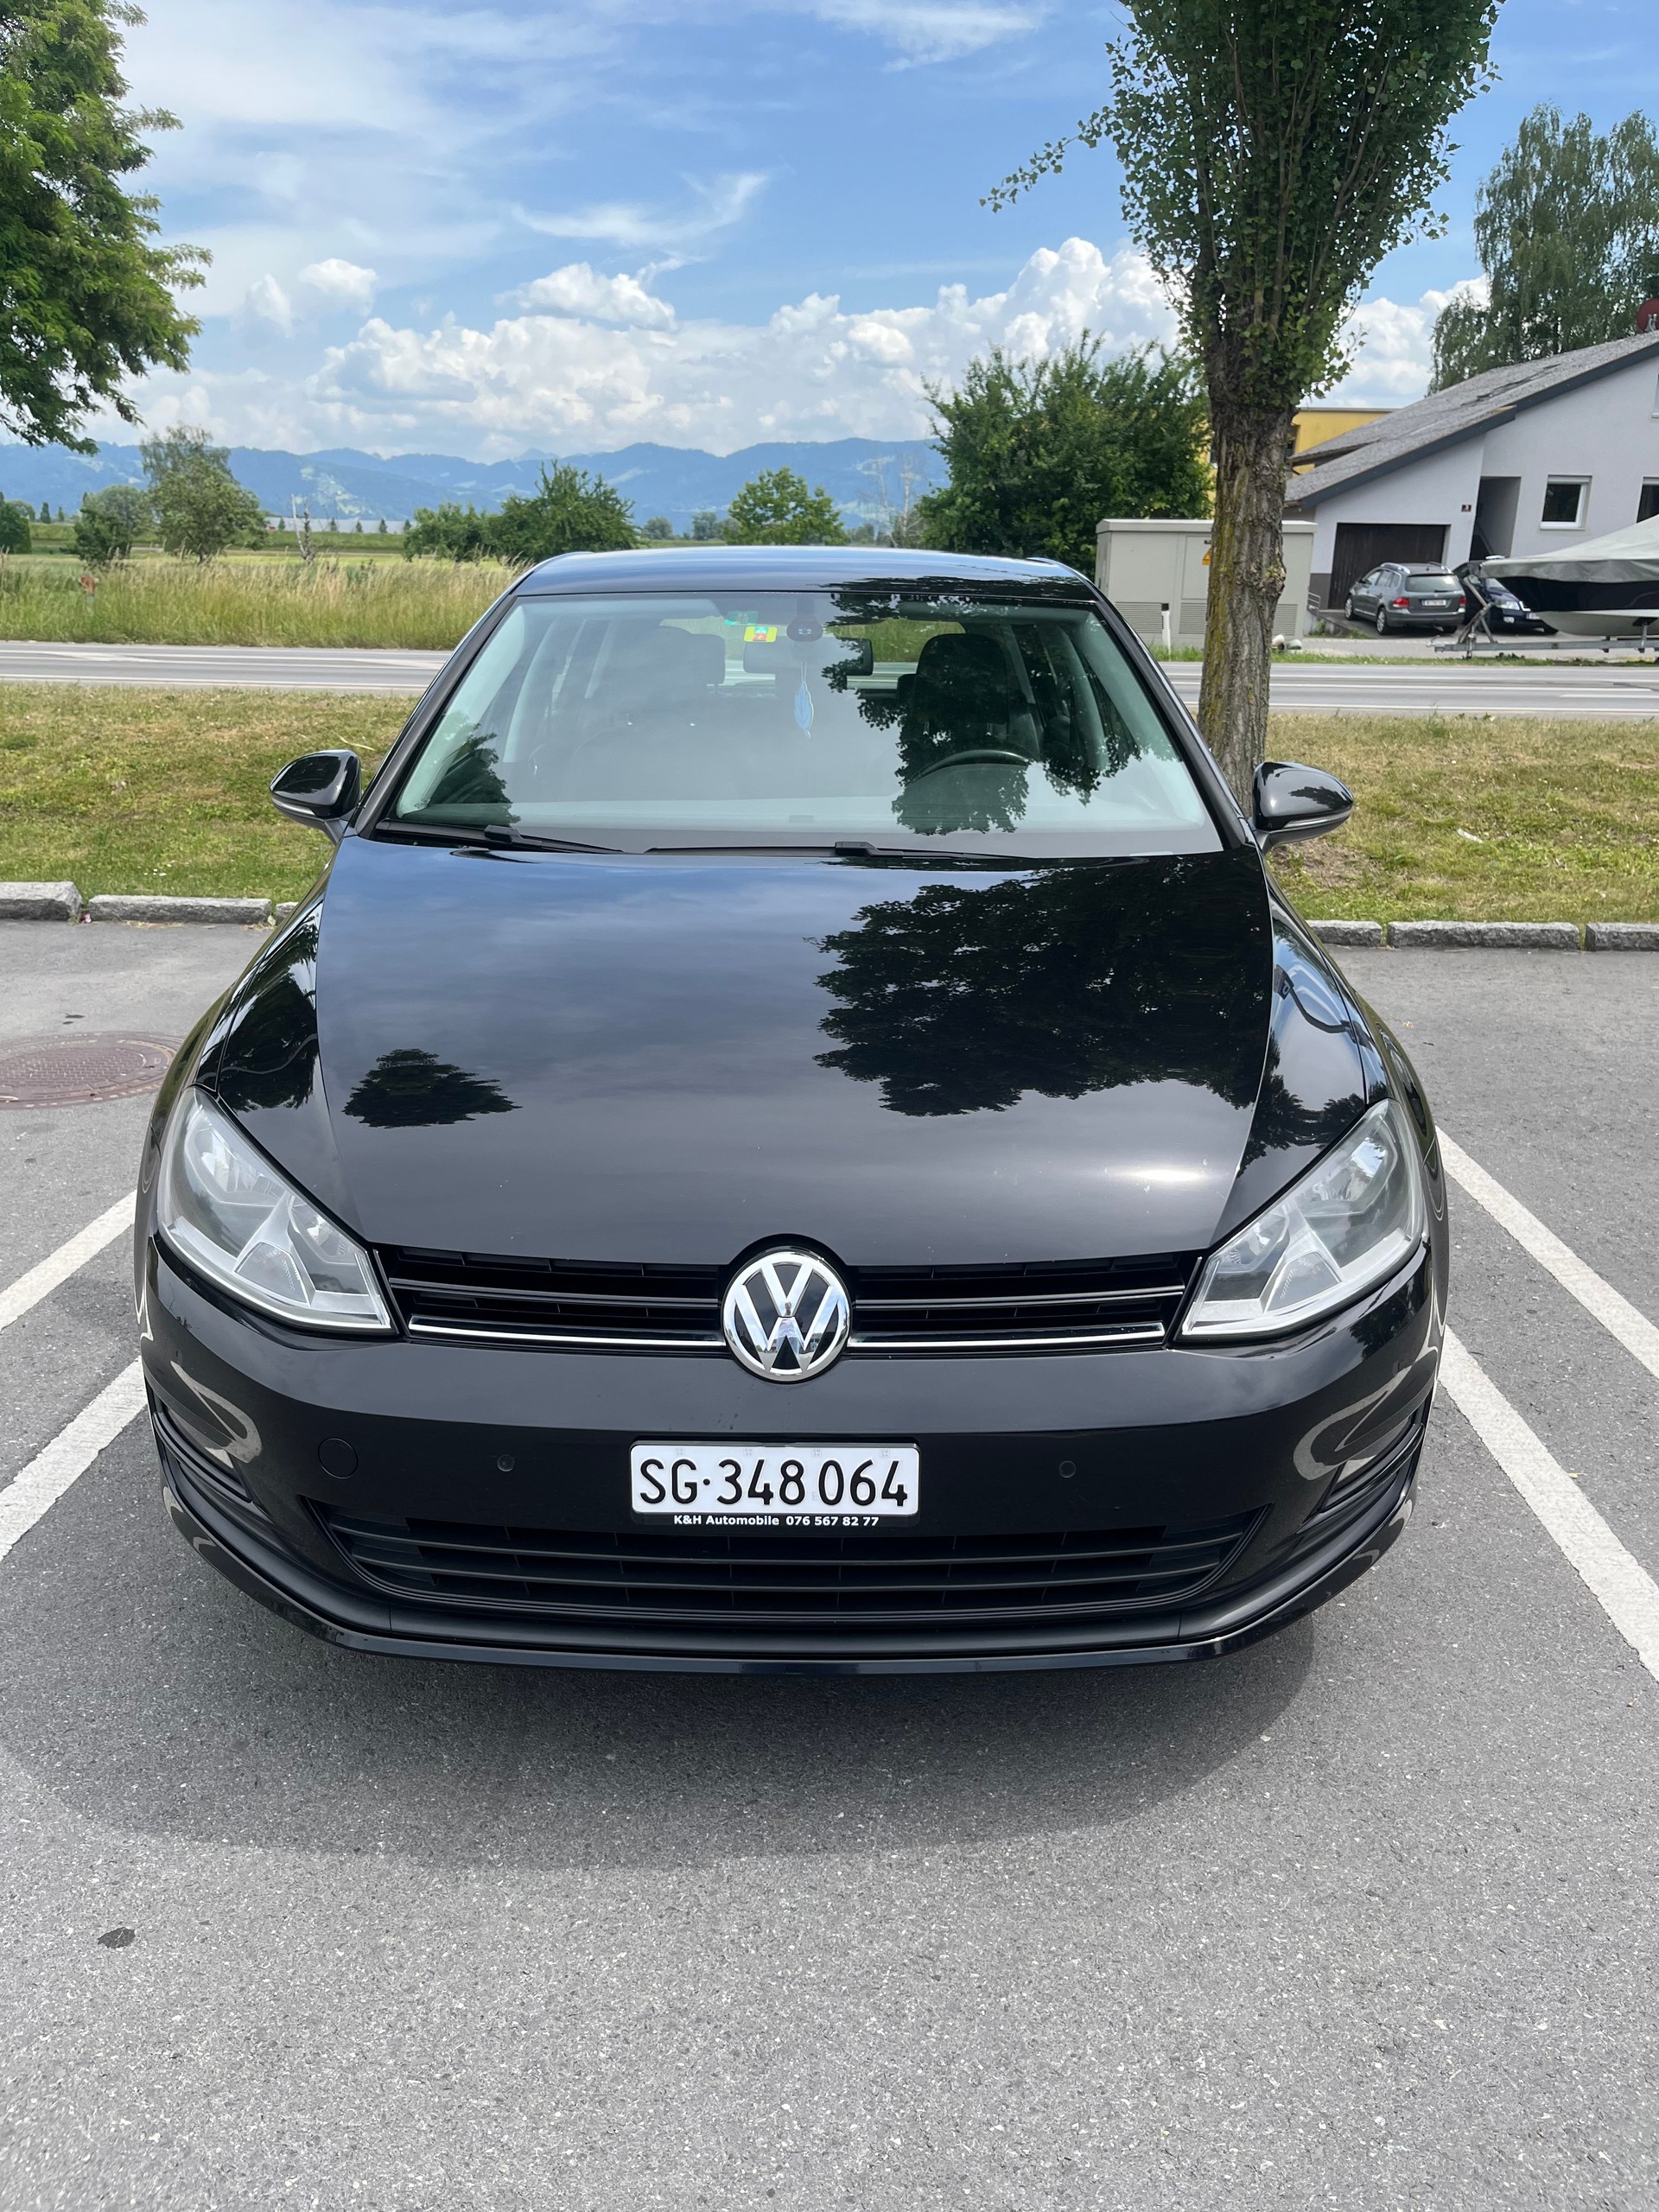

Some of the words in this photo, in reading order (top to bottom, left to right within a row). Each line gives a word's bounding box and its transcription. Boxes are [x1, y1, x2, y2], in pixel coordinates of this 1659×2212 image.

[674, 1515, 702, 1525] K&H
[706, 1515, 779, 1526] Automobile
[785, 1516, 810, 1526] 076
[814, 1516, 839, 1526] 567
[842, 1516, 860, 1526] 82
[863, 1516, 880, 1527] 77
